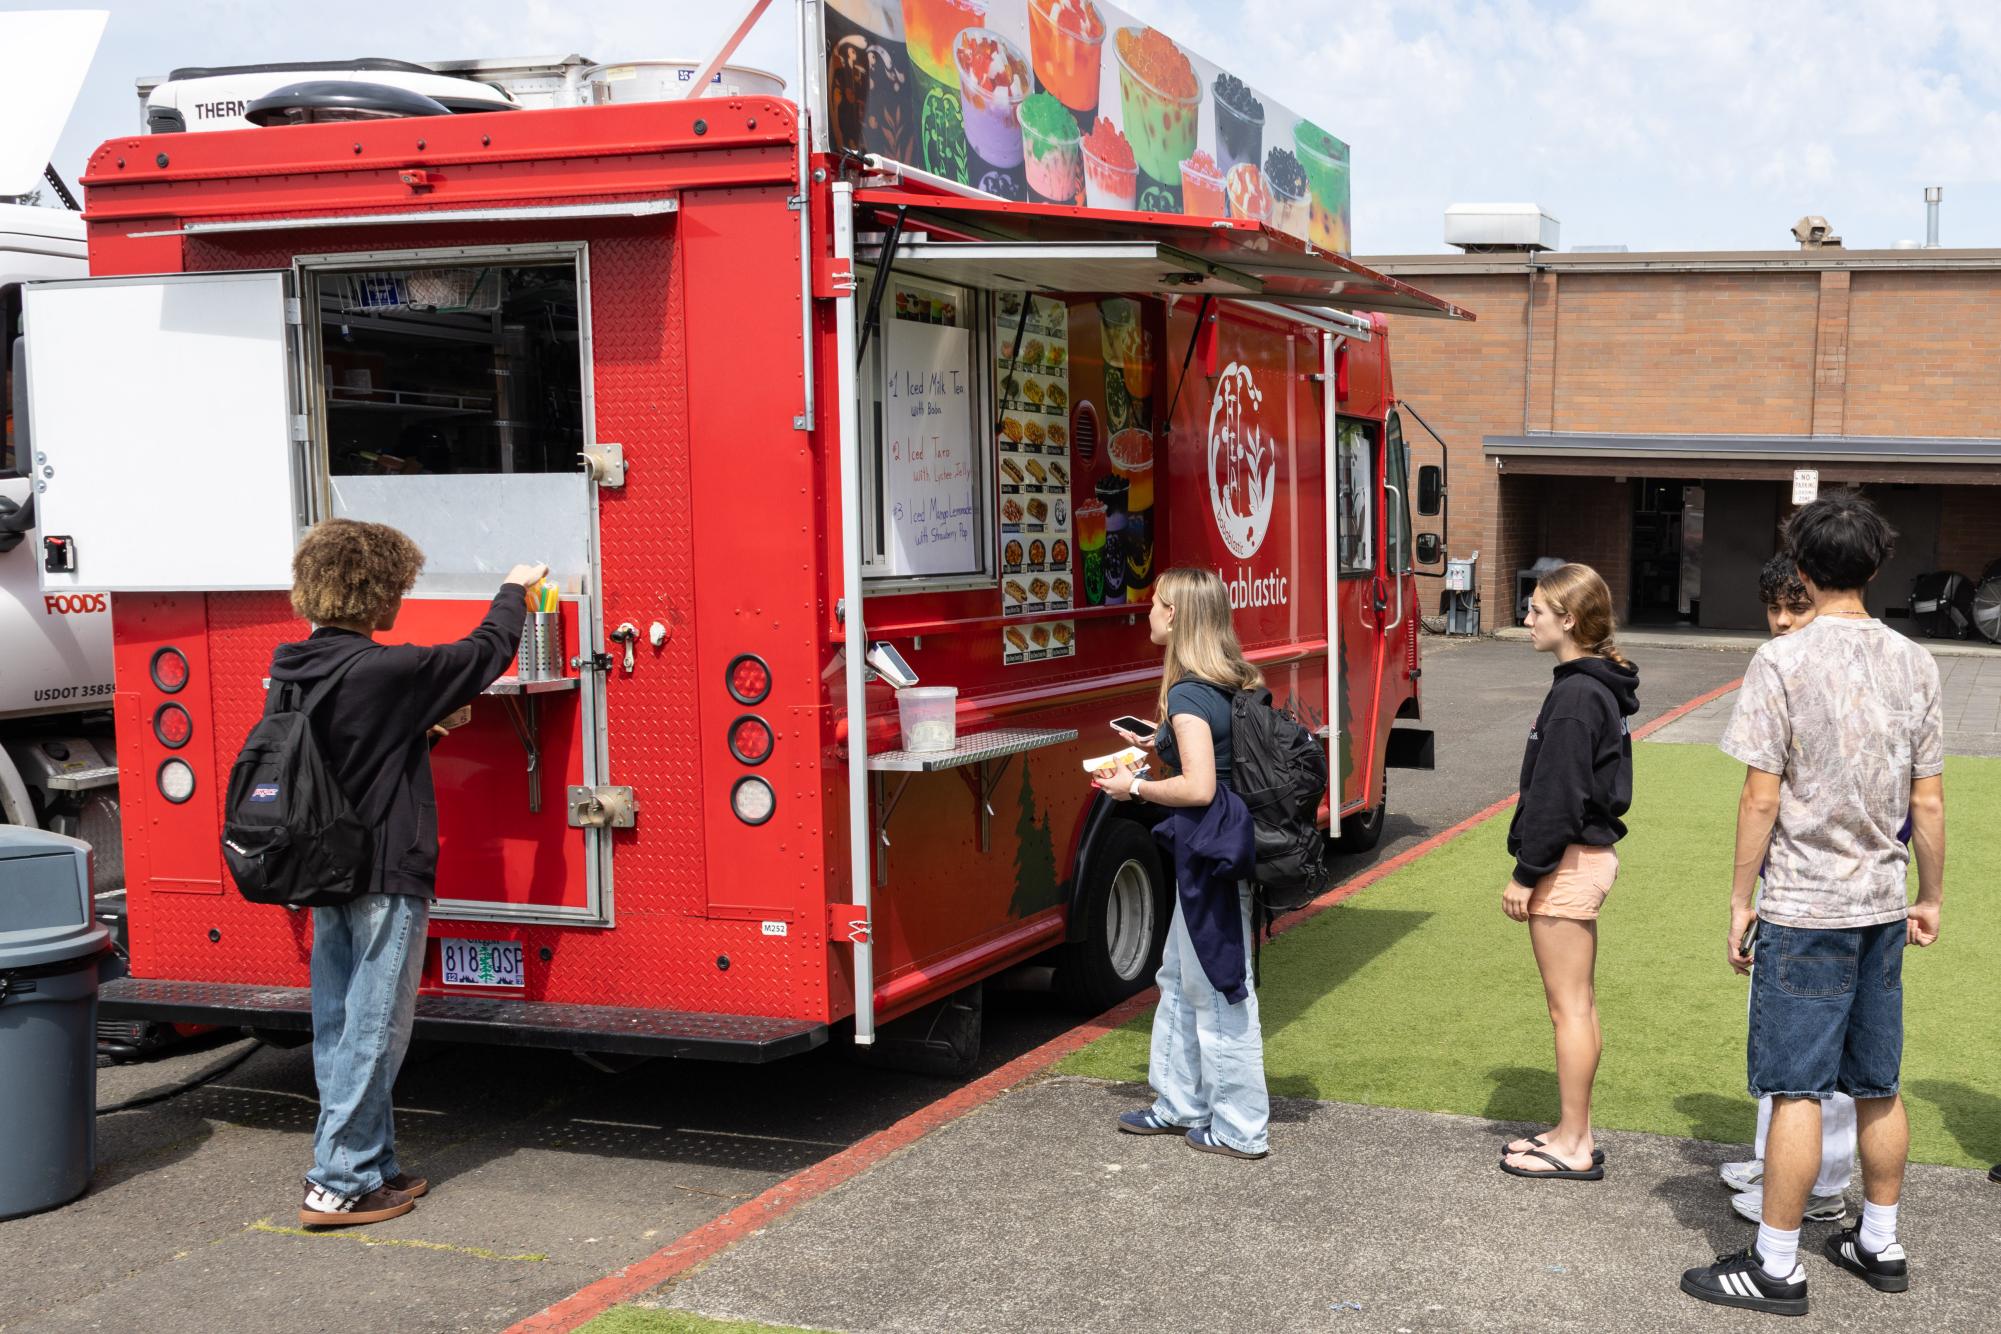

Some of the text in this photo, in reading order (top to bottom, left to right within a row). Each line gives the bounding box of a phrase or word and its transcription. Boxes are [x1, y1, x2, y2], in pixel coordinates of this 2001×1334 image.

[889, 370, 964, 397] #1 Iced Milk Tea
[911, 401, 942, 417] with Boba
[908, 435, 924, 464] Iced
[931, 436, 951, 459] Taro
[912, 465, 929, 482] with
[1801, 473, 1810, 481] NO
[909, 496, 925, 524] Iced
[915, 527, 929, 546] with
[43, 593, 107, 615] FOODS
[34, 686, 79, 702] USDOT
[764, 925, 785, 933] M252
[446, 946, 479, 972] 818
